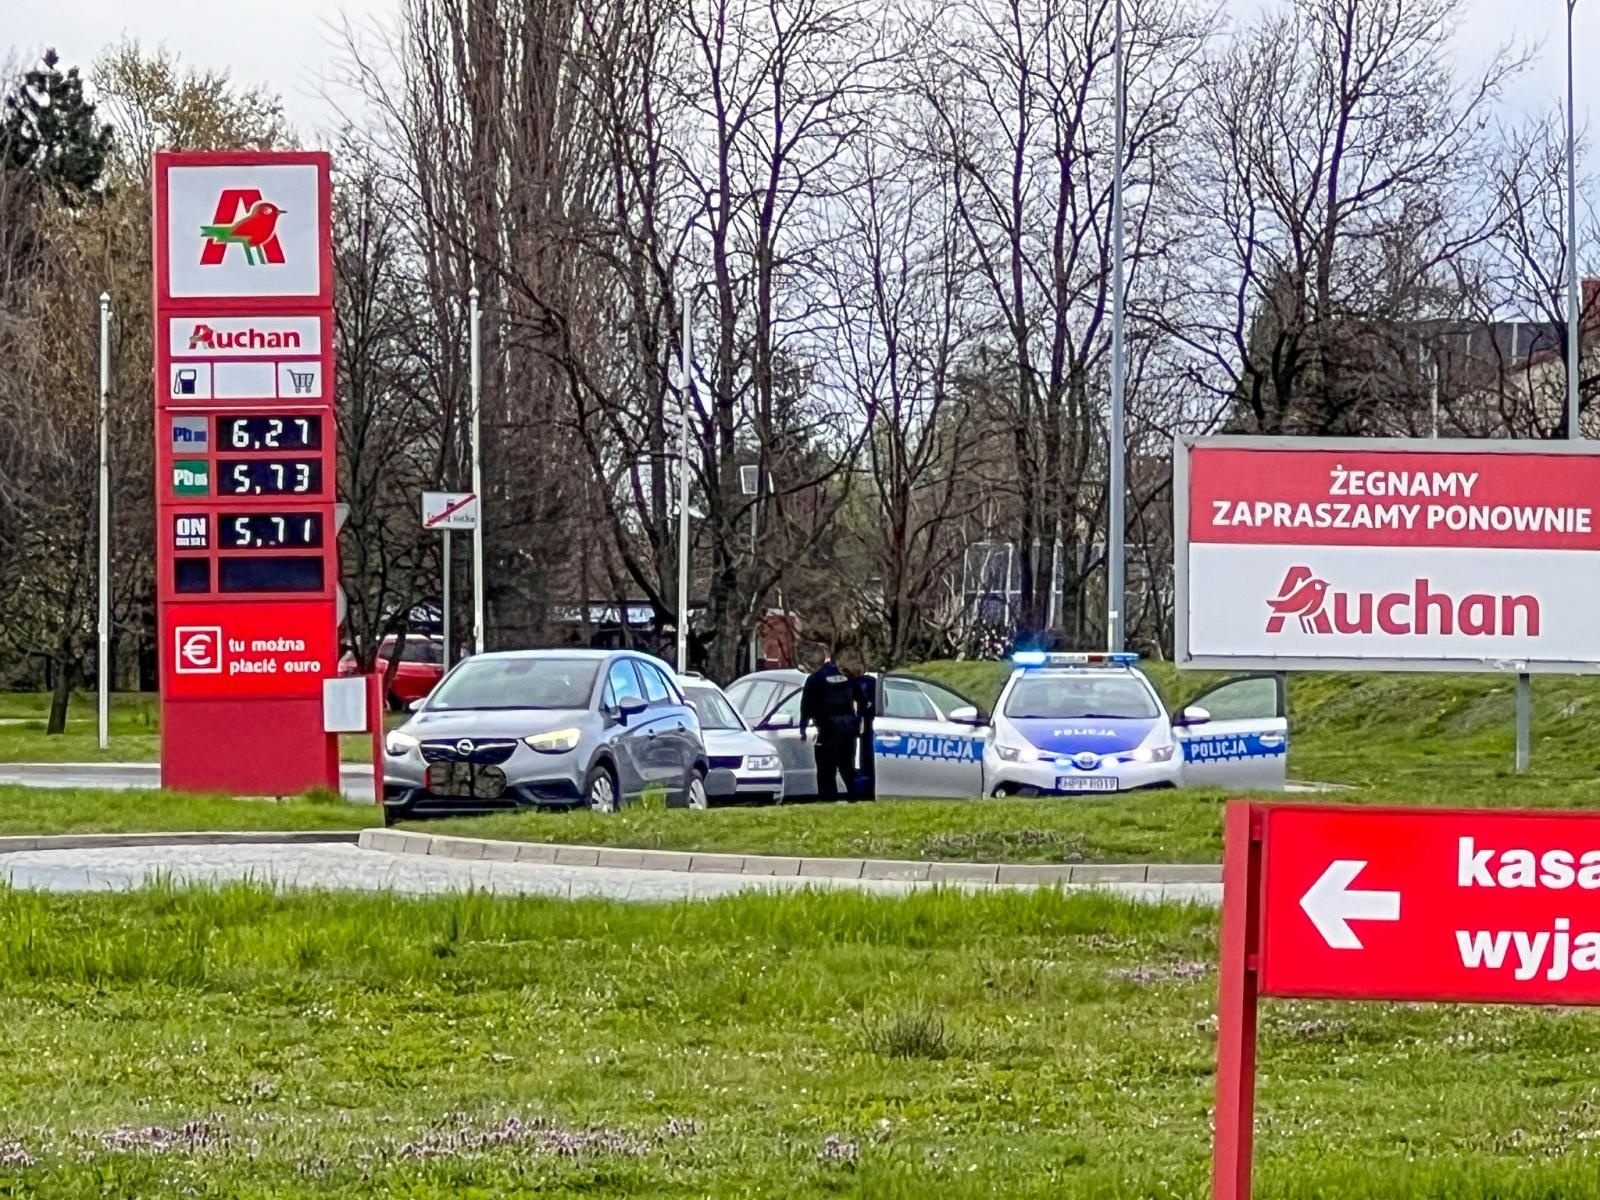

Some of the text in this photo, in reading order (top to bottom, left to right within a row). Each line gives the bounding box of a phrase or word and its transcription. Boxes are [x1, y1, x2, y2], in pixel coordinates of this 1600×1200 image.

[188, 324, 301, 350] Auchan
[1329, 464, 1479, 497] ŻEGNAMY
[176, 517, 206, 536] ON
[1212, 500, 1592, 533] ZAPRASZAMY PONOWNIE
[1265, 566, 1540, 637] Auchan
[228, 637, 305, 652] tu można
[284, 660, 321, 673] euro
[906, 737, 974, 759] POLICJA
[1190, 739, 1248, 758] POLICJA
